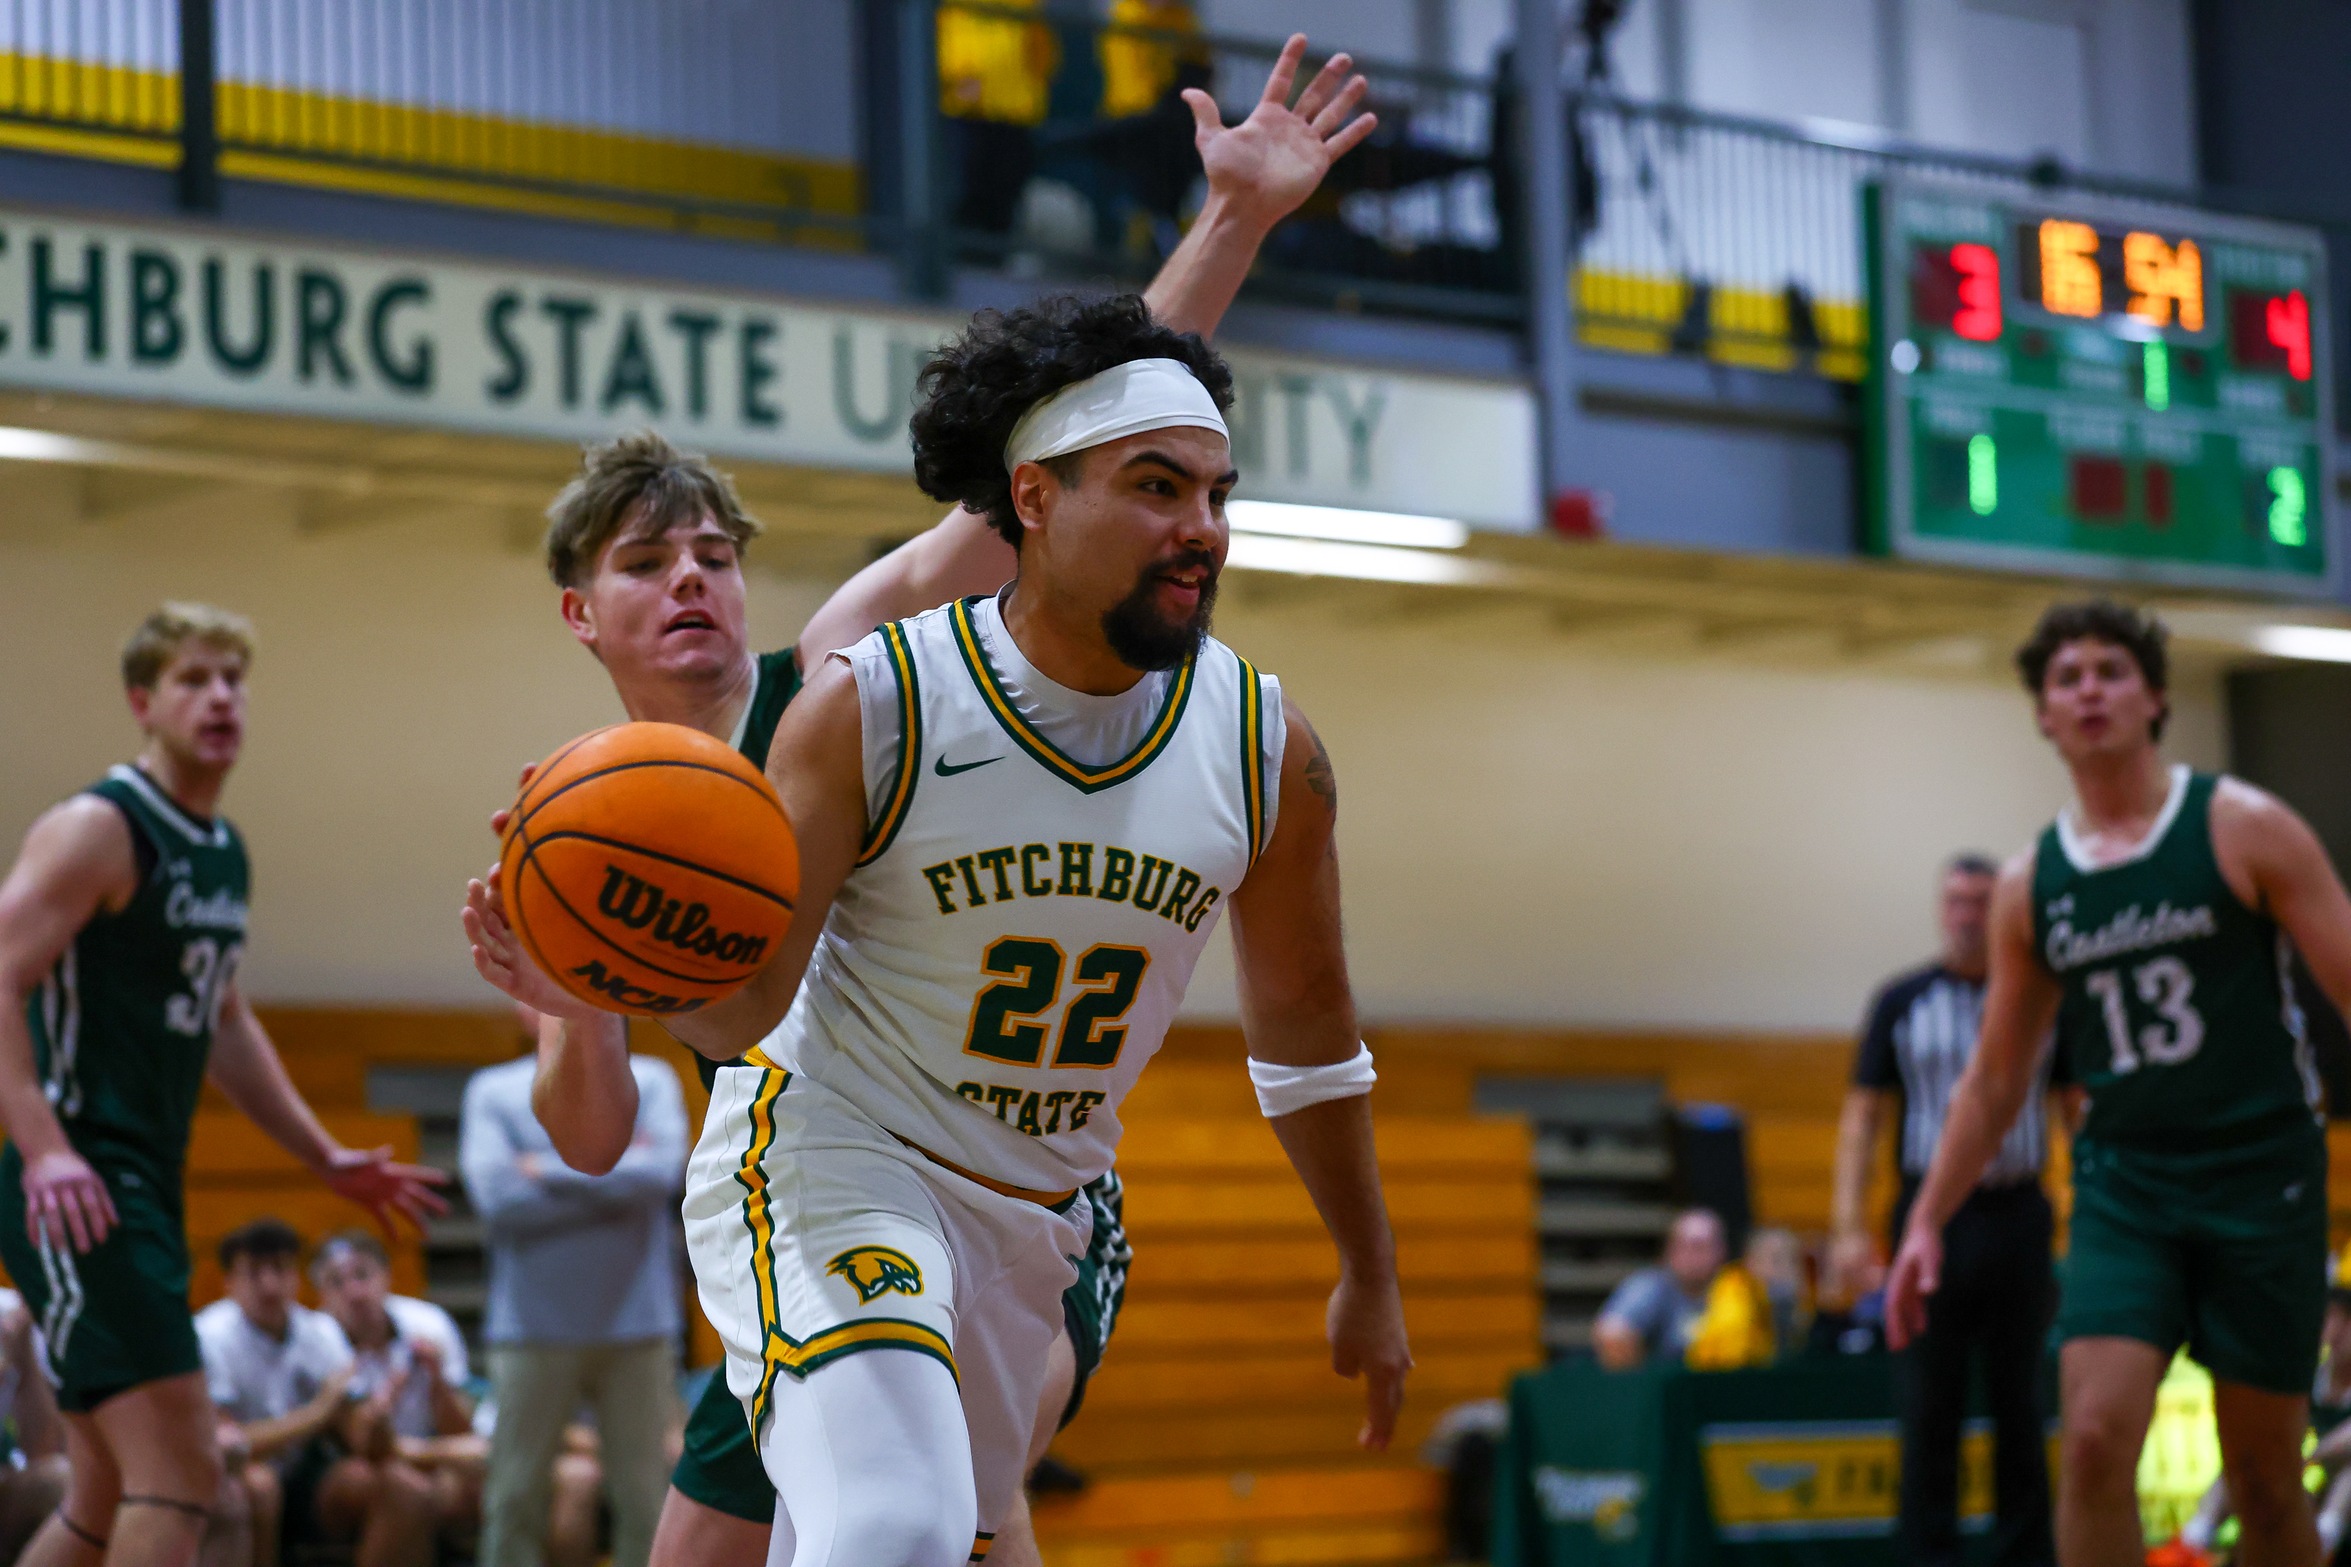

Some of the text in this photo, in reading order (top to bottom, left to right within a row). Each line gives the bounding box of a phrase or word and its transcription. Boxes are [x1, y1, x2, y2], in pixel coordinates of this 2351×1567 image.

[0, 228, 434, 394] HBURG
[485, 291, 783, 428] STATE
[1950, 243, 2002, 342] 3
[2266, 289, 2312, 381] 4
[2143, 336, 2169, 411] 1
[1968, 434, 1997, 516] 1
[2267, 466, 2306, 546] 2
[597, 863, 769, 965] Wilson
[921, 842, 1221, 933] FITCHBURG
[962, 934, 1152, 1070] 22
[2085, 956, 2206, 1076] 13
